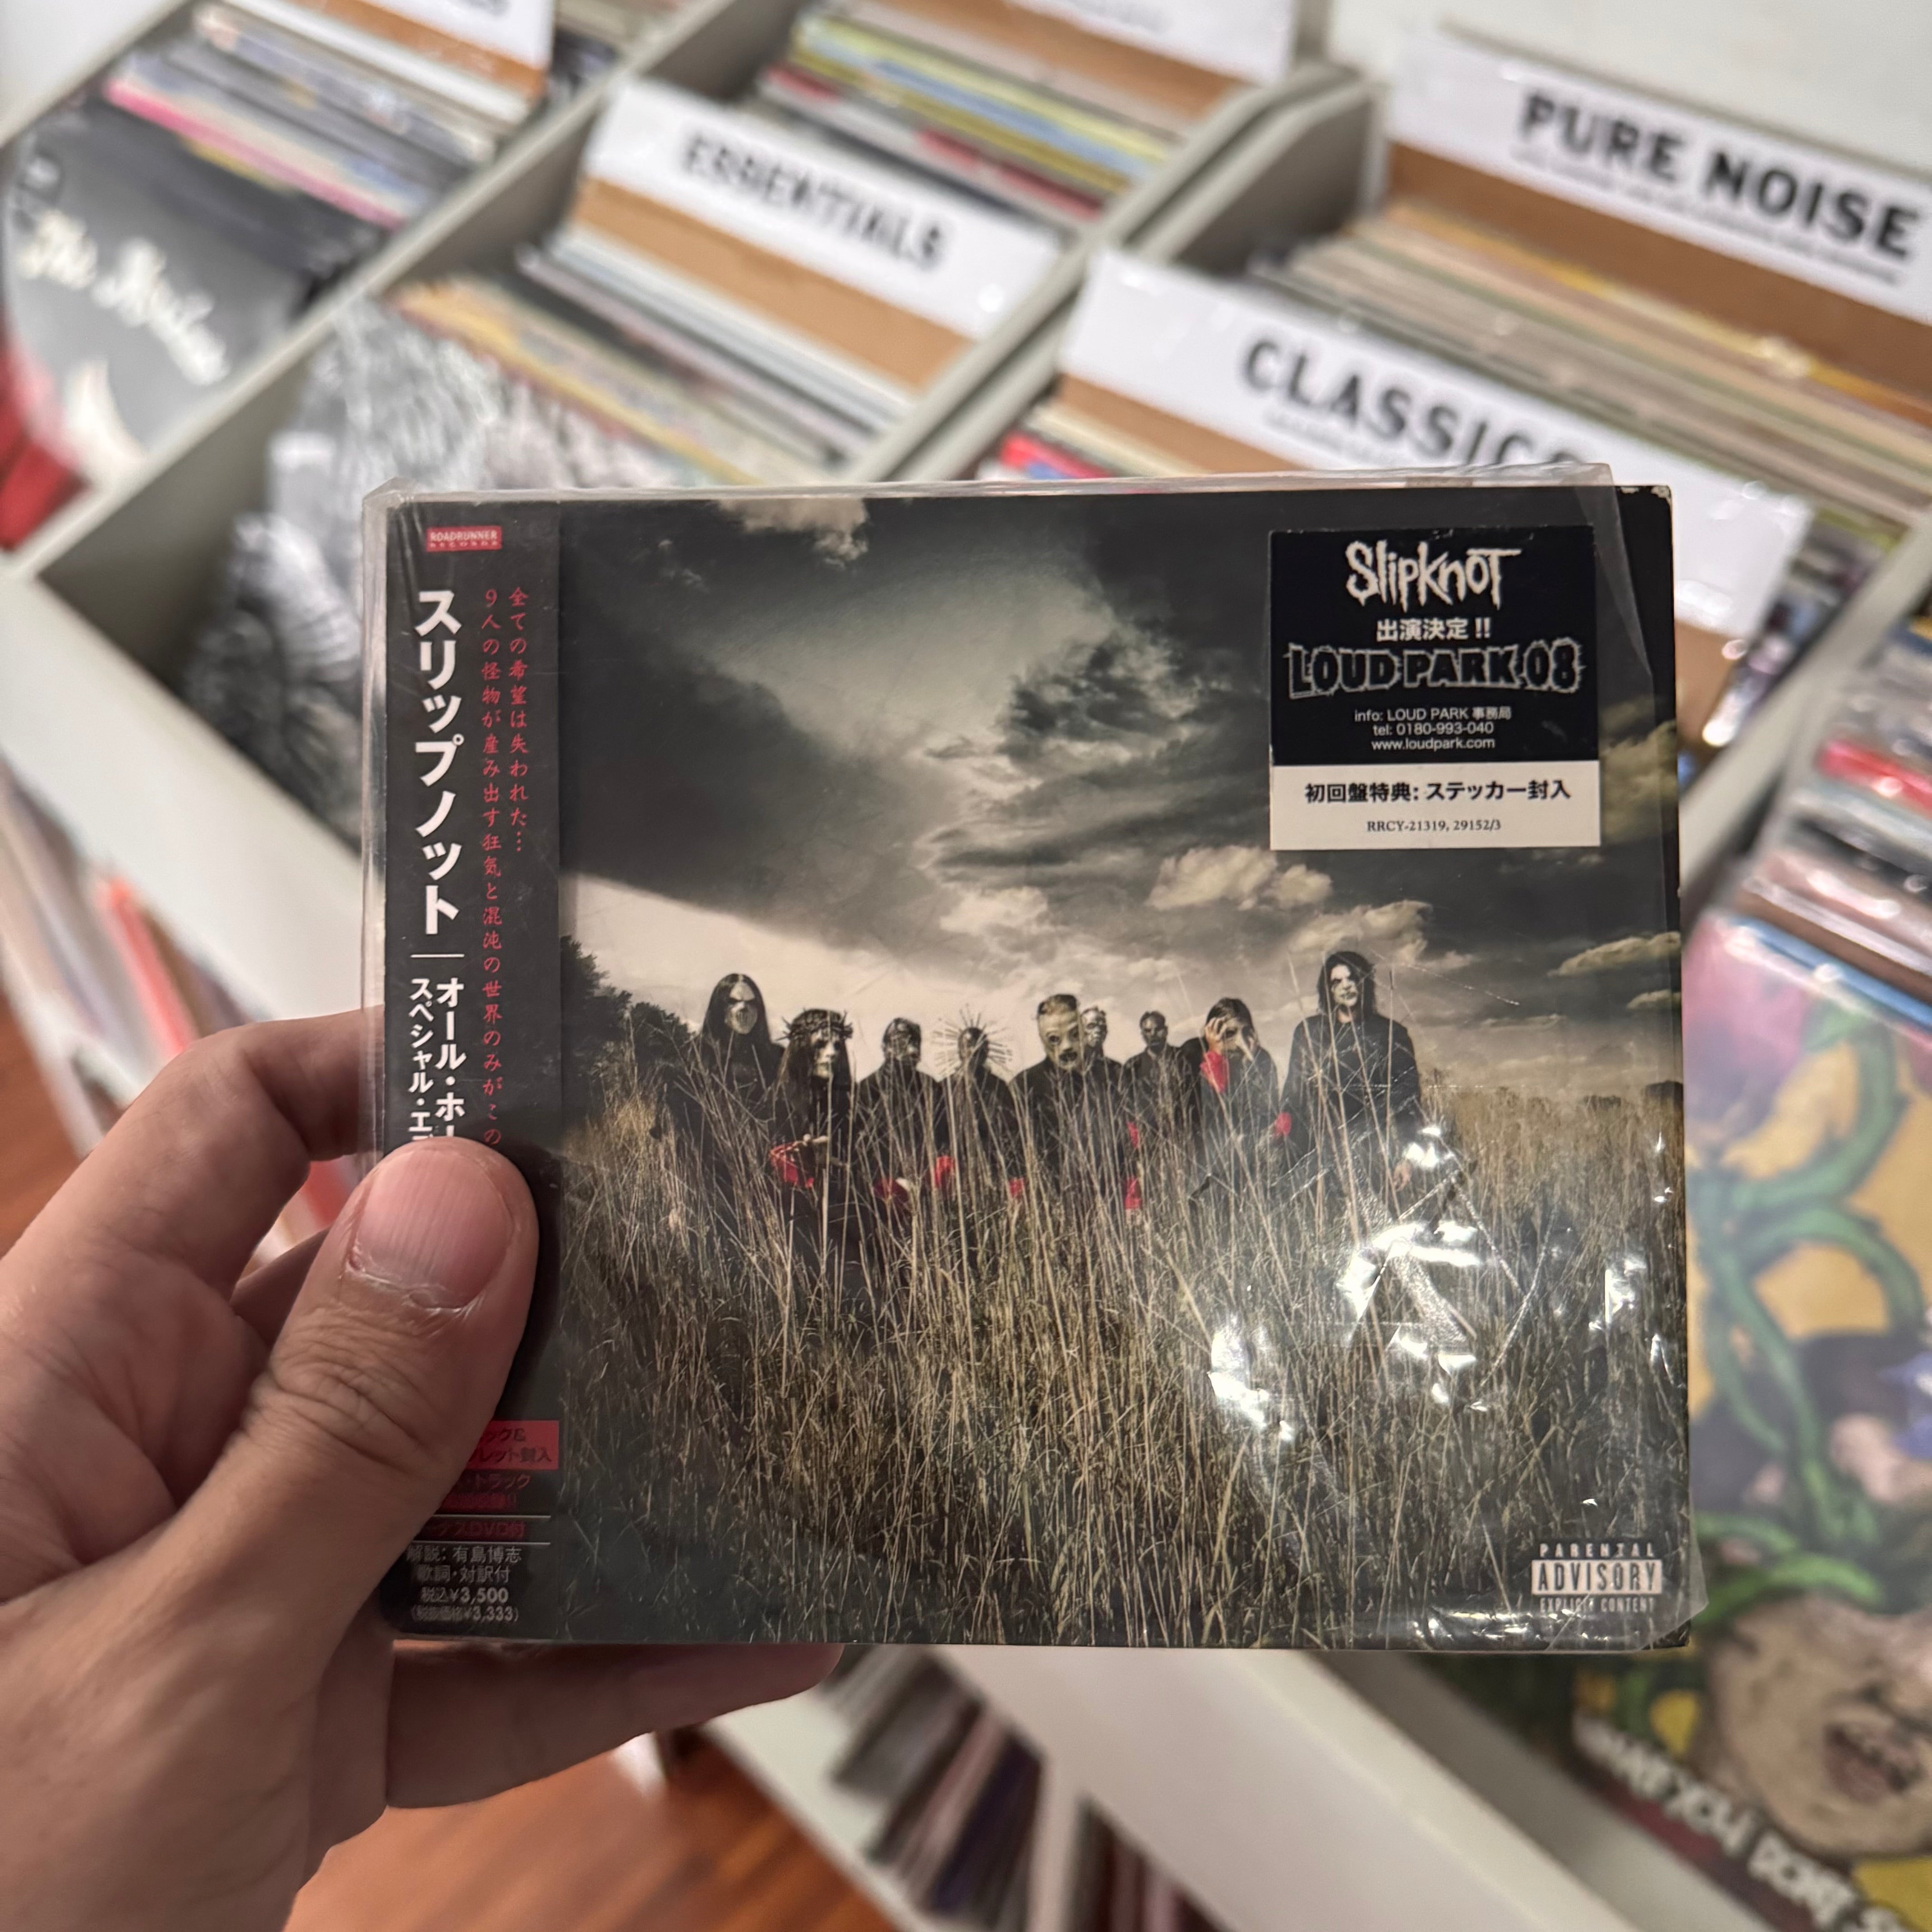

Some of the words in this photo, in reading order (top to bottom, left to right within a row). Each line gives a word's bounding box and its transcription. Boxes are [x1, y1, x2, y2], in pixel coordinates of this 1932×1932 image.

[1519, 92, 1683, 181] PURE
[1706, 150, 1919, 261] NOISE
[682, 133, 945, 271] ESSENTIALS
[430, 529, 498, 542] ROADRUNNER
[1283, 642, 1402, 699] LOUD
[1403, 644, 1522, 689] PARK
[1354, 709, 1383, 722] info:
[1387, 708, 1426, 721] LOUD
[1430, 707, 1469, 720] PARK
[1472, 706, 1511, 720] 事務局
[1372, 724, 1392, 736] tel:
[1396, 722, 1494, 736] 0180-993-040
[1371, 737, 1495, 752] www.loudpark.com
[414, 590, 465, 935] スリップノット
[1366, 820, 1450, 833] RRCY-21319,
[1453, 819, 1501, 832] 29152/3
[1539, 1543, 1655, 1557] PARENTAL
[1537, 1562, 1656, 1591] ADVISORY
[1601, 1597, 1655, 1613] CONTENT
